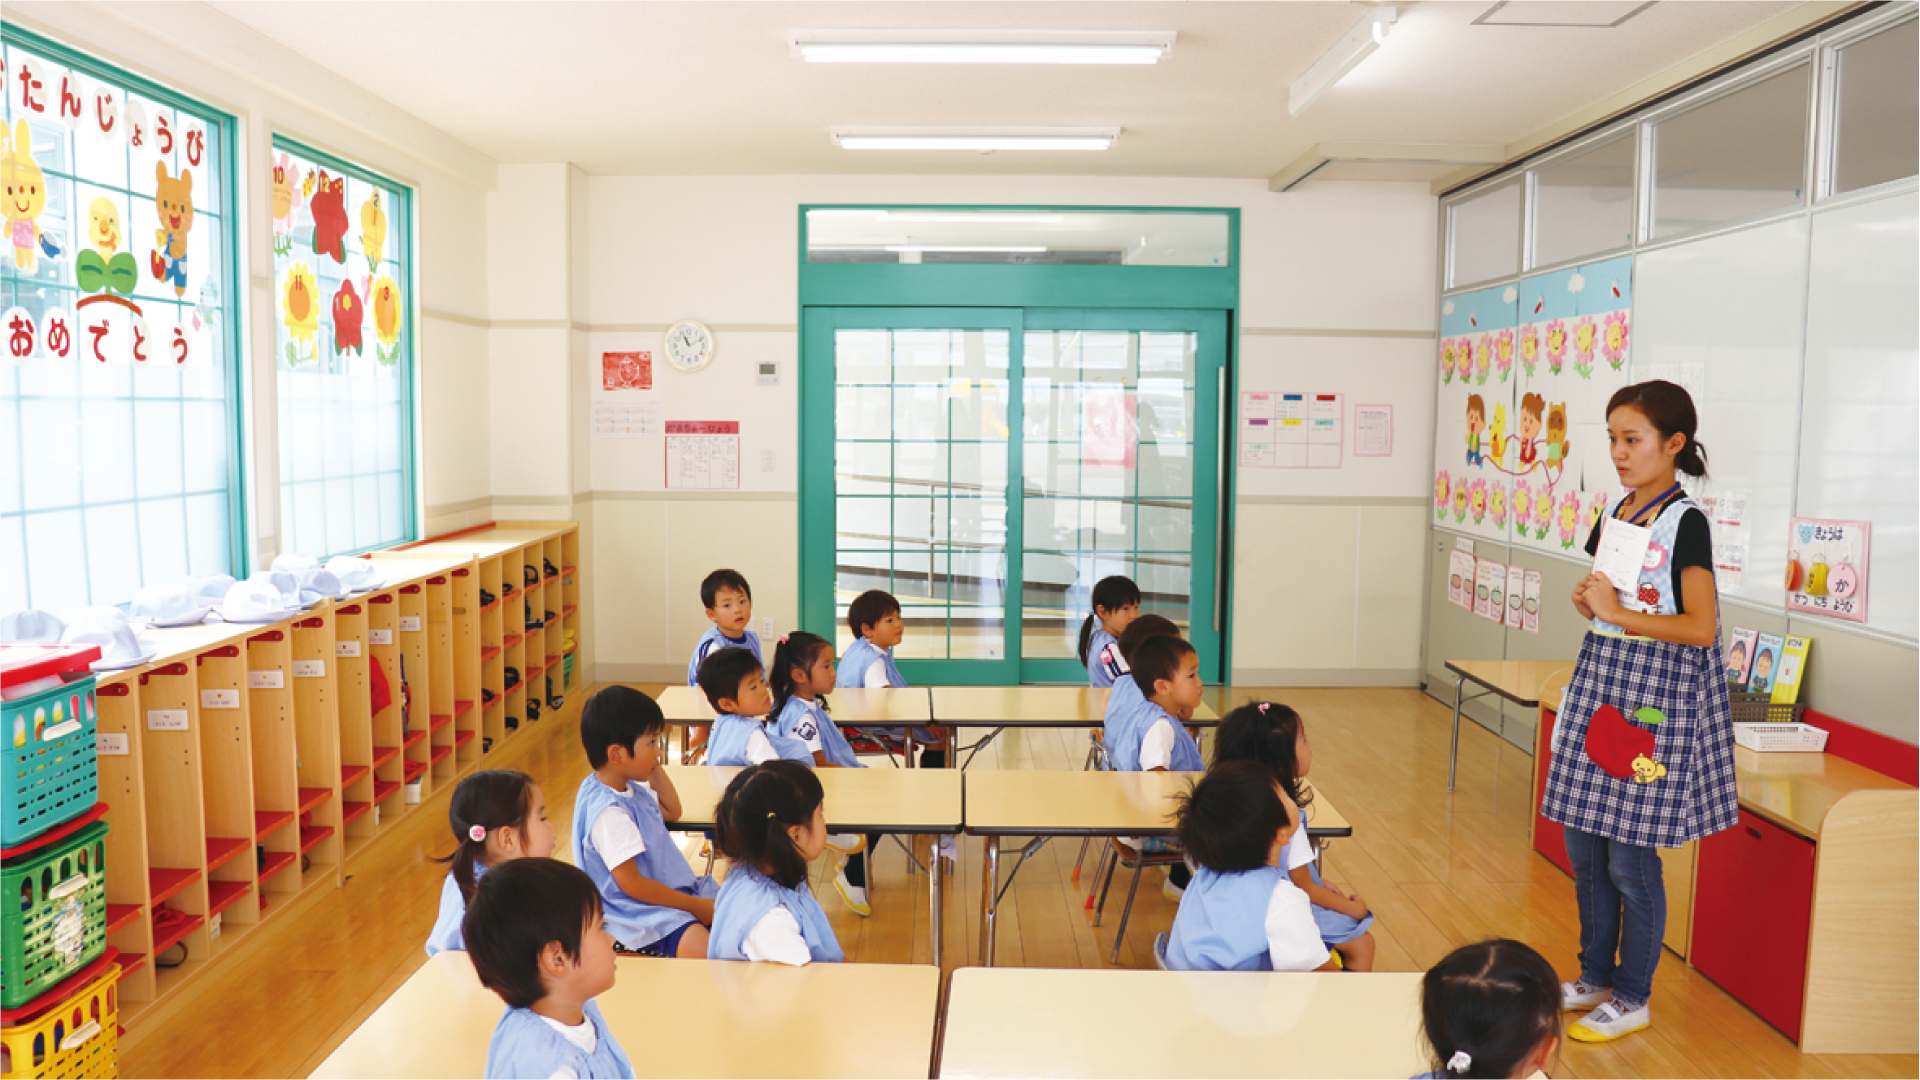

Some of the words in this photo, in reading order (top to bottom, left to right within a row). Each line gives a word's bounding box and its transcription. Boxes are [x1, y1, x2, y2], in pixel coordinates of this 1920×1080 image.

[273, 166, 284, 185] 10
[320, 177, 331, 193] 12
[8, 313, 188, 364] おめでとう
[1814, 526, 1843, 541] きょうは
[1835, 578, 1850, 593] か
